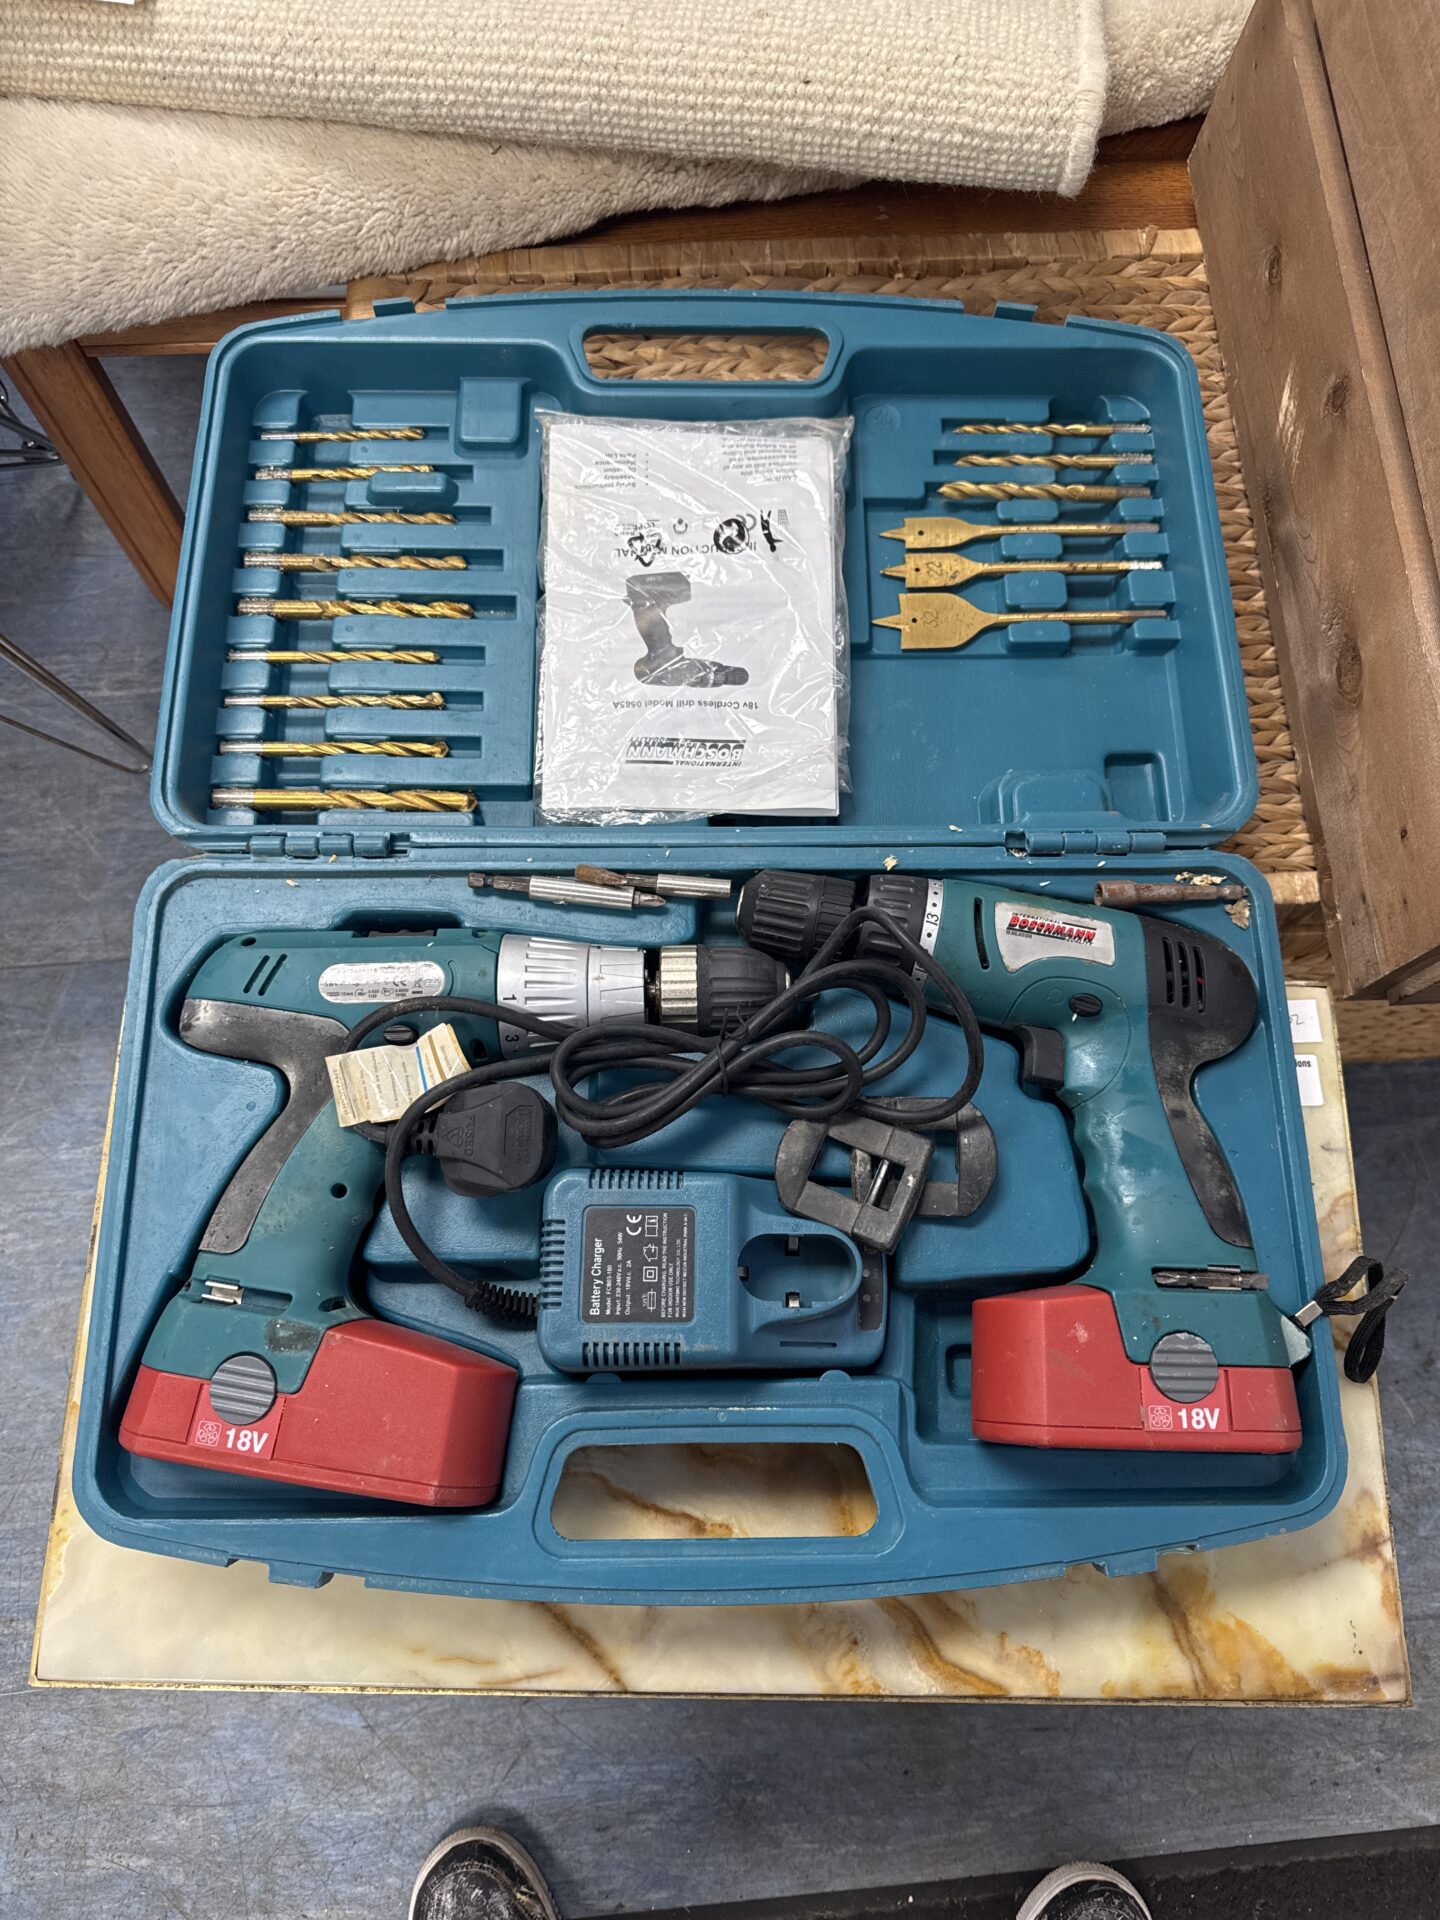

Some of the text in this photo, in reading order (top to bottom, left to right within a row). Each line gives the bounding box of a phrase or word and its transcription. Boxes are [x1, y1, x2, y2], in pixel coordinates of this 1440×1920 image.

[698, 701, 740, 709] Cordless
[743, 701, 758, 709] 18v
[626, 742, 744, 761] BOSCHMANN
[926, 913, 939, 925] 13
[1012, 912, 1061, 924] INTERNATIONAL
[1008, 916, 1096, 941] BOSCHMANN
[505, 1034, 519, 1043] 3
[464, 1112, 475, 1156] FUSED
[627, 1260, 632, 1268] 2A
[590, 1238, 604, 1315] Battery Charger
[1178, 1408, 1220, 1429] 18V
[226, 1428, 269, 1454] 18V
